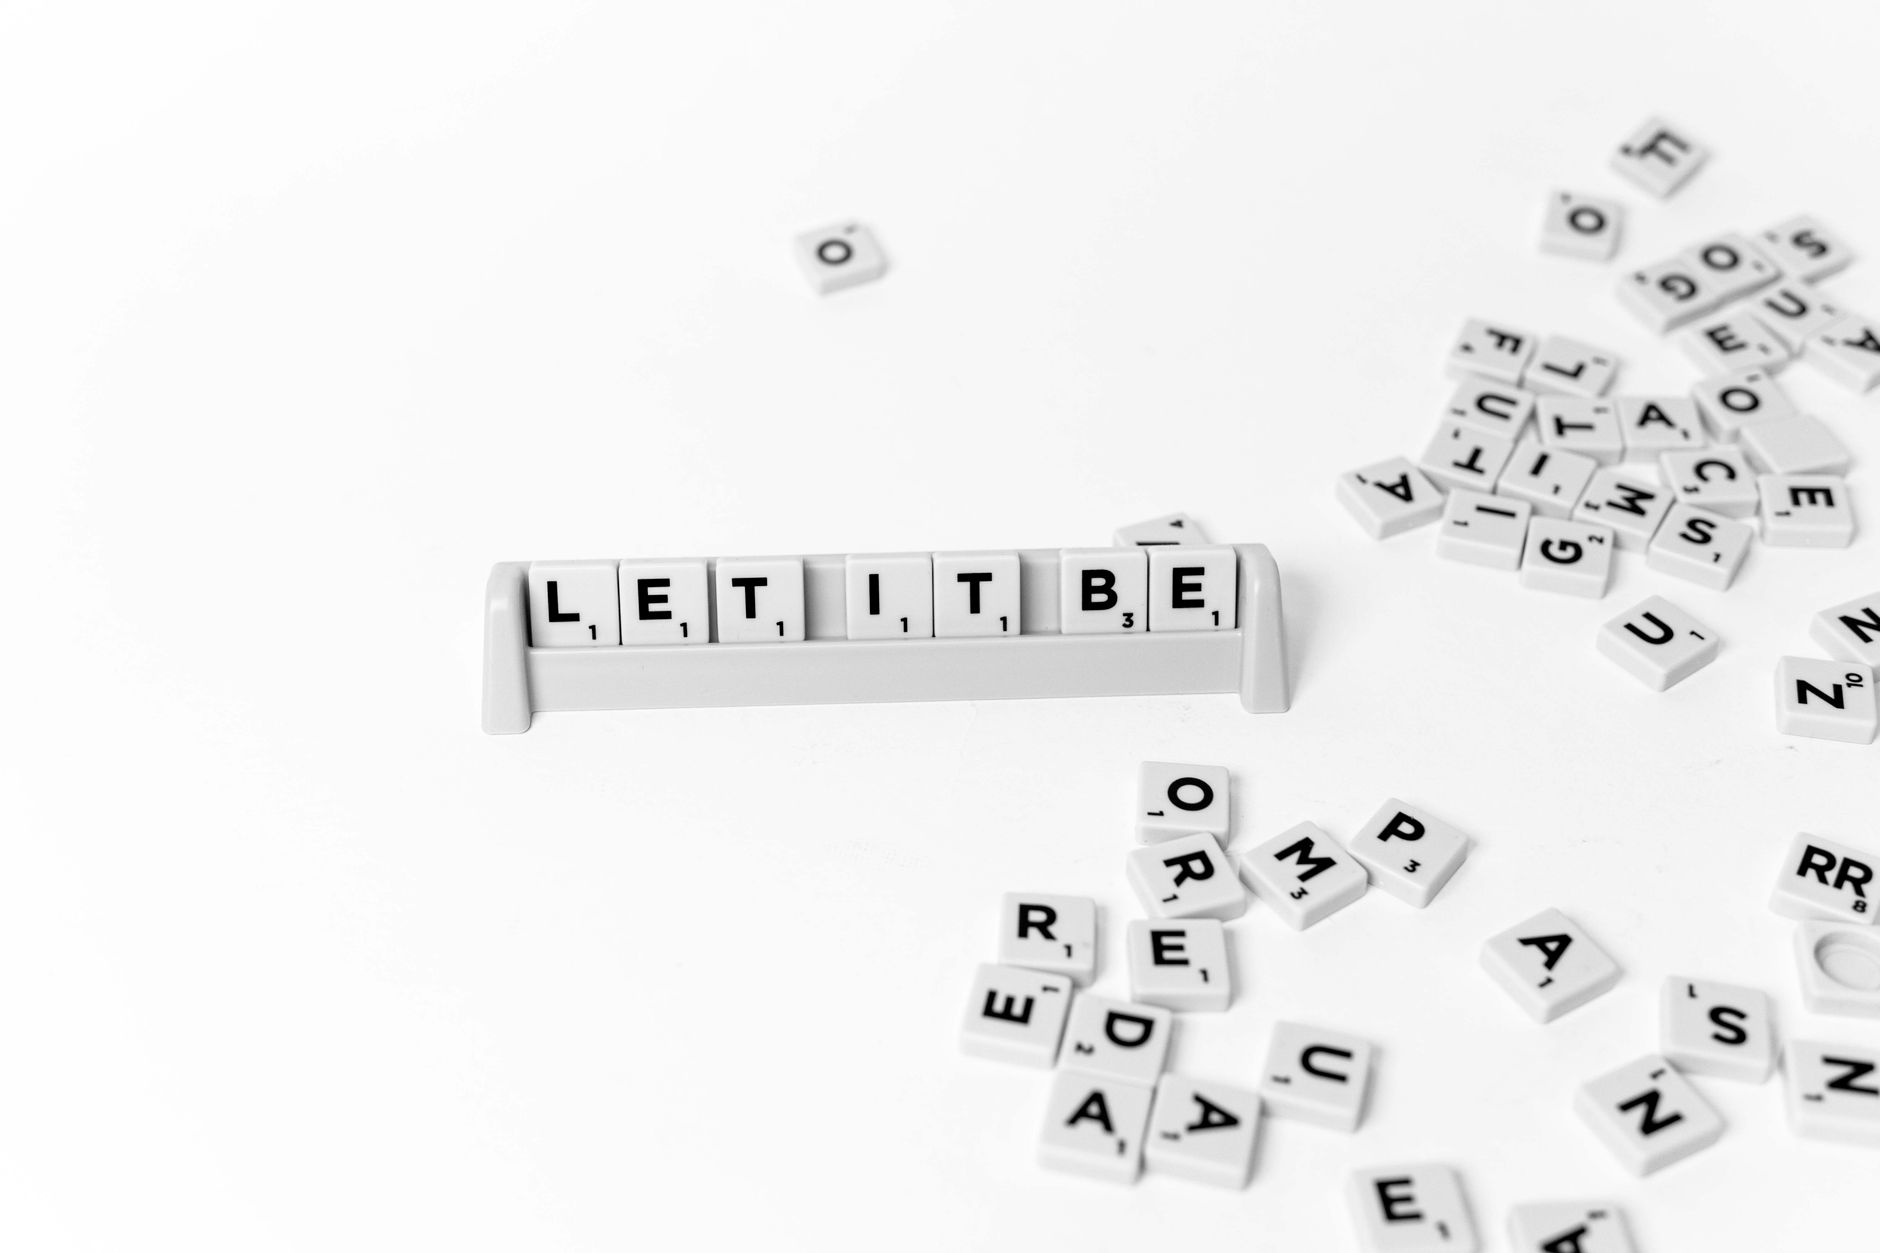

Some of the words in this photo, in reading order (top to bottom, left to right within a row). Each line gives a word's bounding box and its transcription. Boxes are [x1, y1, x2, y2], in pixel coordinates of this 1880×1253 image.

[1567, 207, 1606, 235] O
[817, 240, 853, 265] O
[1701, 245, 1740, 271] O
[1790, 230, 1828, 258] S
[1658, 274, 1698, 301] G
[1764, 289, 1808, 319] U
[1485, 327, 1524, 357] F
[1703, 324, 1749, 354] E
[1843, 327, 1880, 355] A
[1542, 361, 1586, 381] L
[1474, 392, 1518, 421] U
[1636, 402, 1677, 428] A
[1719, 387, 1761, 414] O
[1553, 415, 1595, 437] T
[1452, 446, 1486, 476] T
[1693, 459, 1738, 483] C
[1373, 472, 1415, 504] A
[1604, 482, 1657, 518] M
[1787, 485, 1836, 509] E
[1678, 517, 1719, 546] S
[1539, 537, 1585, 566] G
[547, 577, 768, 623] LET
[869, 572, 993, 616] IT
[1081, 566, 1206, 612] BE
[588, 624, 597, 641] 1
[679, 621, 688, 638] 1
[775, 620, 785, 637] 1
[900, 616, 909, 633] 1
[999, 615, 1008, 632] 1
[1121, 612, 1135, 629] 3
[1211, 610, 1220, 627] 1
[1623, 611, 1675, 646] U
[1837, 606, 1880, 644] N
[1166, 776, 1215, 812] O
[1376, 811, 1427, 843] P
[1162, 849, 1216, 888] R
[1272, 836, 1338, 883] M
[1403, 858, 1422, 873] 3
[1795, 843, 1875, 900] RR
[1289, 886, 1310, 901] 3
[1851, 898, 1869, 915] 8
[1017, 903, 1059, 942] R
[1063, 943, 1073, 959] 1
[1149, 929, 1191, 967] E
[1516, 932, 1574, 972] A
[981, 988, 1036, 1026] E
[1103, 1009, 1156, 1049] D
[1707, 1005, 1749, 1046] S
[1299, 1043, 1354, 1084] U
[1821, 1055, 1880, 1096] N
[1065, 1089, 1116, 1135] A
[1185, 1092, 1241, 1134] A
[1373, 1175, 1425, 1224] E
